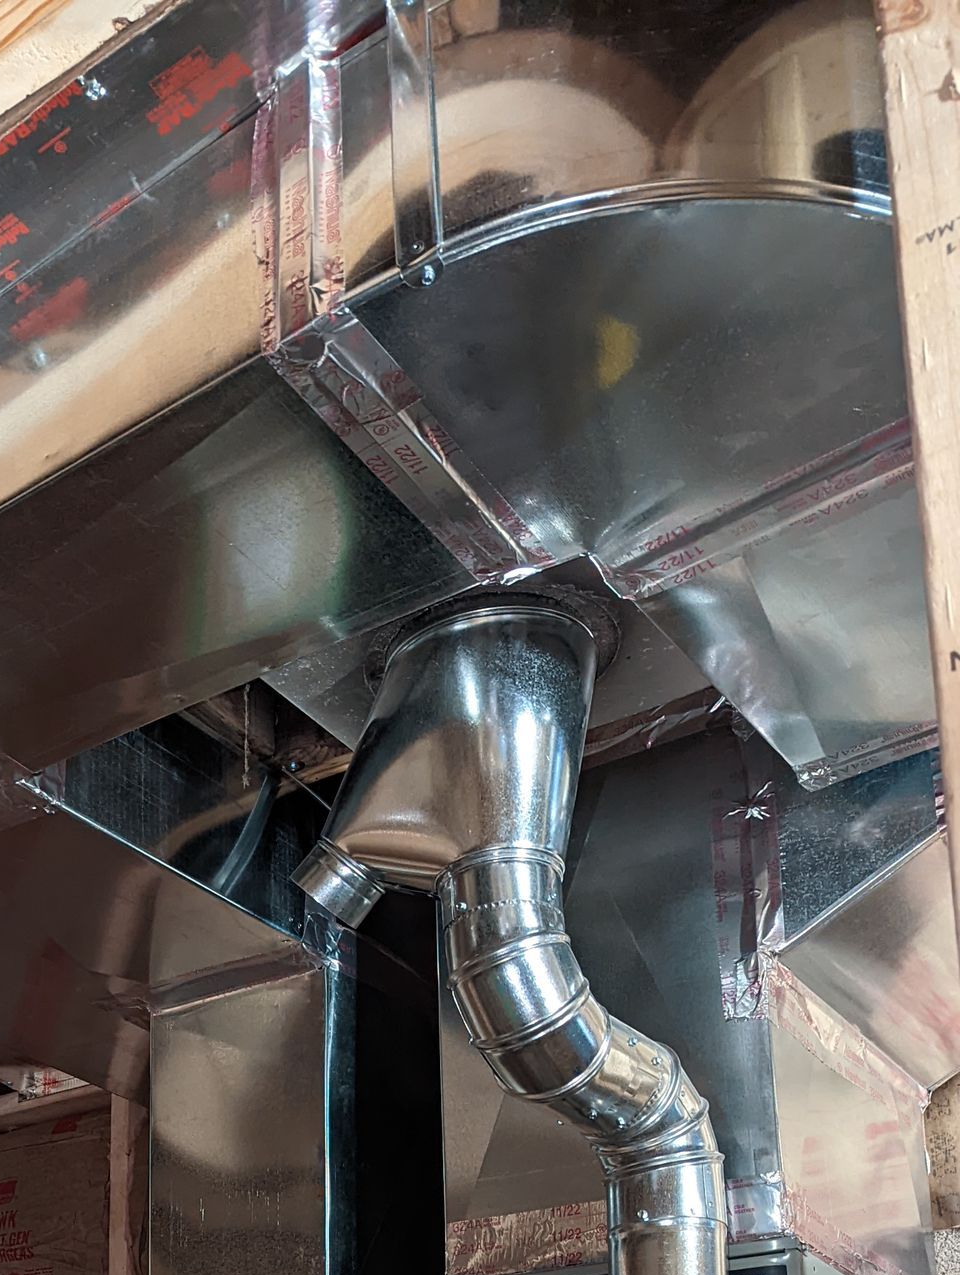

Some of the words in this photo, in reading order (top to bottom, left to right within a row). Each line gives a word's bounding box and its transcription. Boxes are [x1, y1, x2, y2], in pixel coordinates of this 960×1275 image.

[366, 455, 399, 485] 11/22
[394, 443, 429, 474] 11/22
[806, 472, 857, 501] 324A
[816, 488, 869, 516] 324A
[645, 525, 690, 551] 11/22
[658, 546, 705, 571] 11/22
[671, 560, 717, 584] 11/22
[828, 743, 870, 761] 324A
[838, 755, 881, 773] 324A
[551, 1205, 581, 1218] 11/22
[551, 1228, 582, 1242] 11/22
[552, 1252, 583, 1268] 11/22
